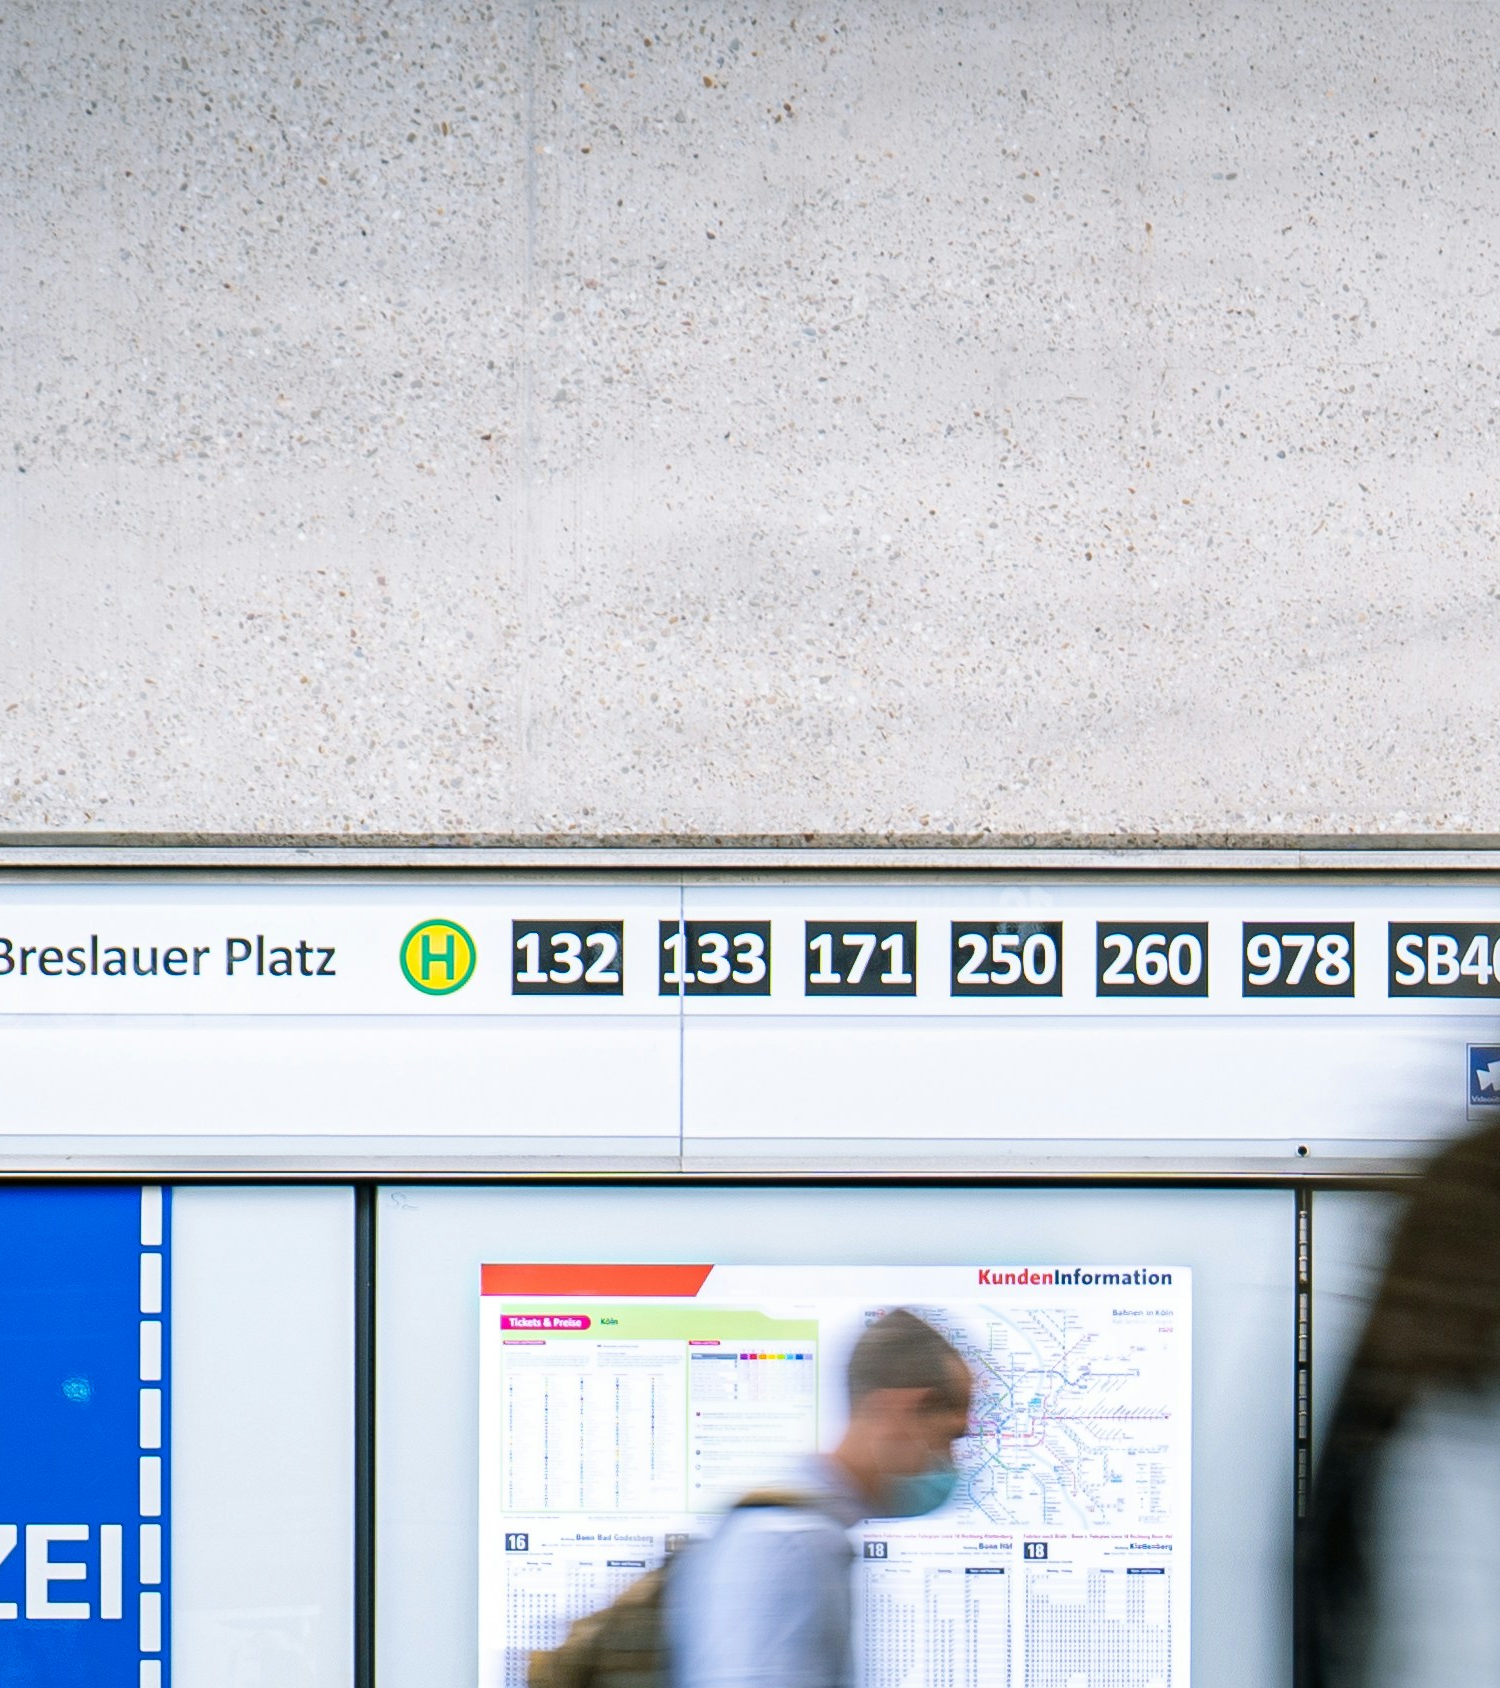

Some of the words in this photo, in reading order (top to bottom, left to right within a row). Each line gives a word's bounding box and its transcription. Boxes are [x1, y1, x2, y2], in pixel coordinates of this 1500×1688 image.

[225, 934, 336, 977] Platz
[421, 934, 455, 981] H
[515, 932, 619, 984] 132
[663, 933, 767, 984] 133
[808, 933, 912, 984] 171
[956, 933, 1057, 985] 250
[1102, 933, 1202, 986] 260
[1247, 934, 1351, 986] 978
[978, 1268, 1173, 1286] KundenInformation
[508, 1317, 541, 1327] Tickets
[553, 1317, 582, 1327] Preise
[508, 1534, 526, 1550] 16
[867, 1543, 885, 1558] 18
[1027, 1543, 1045, 1558] 18
